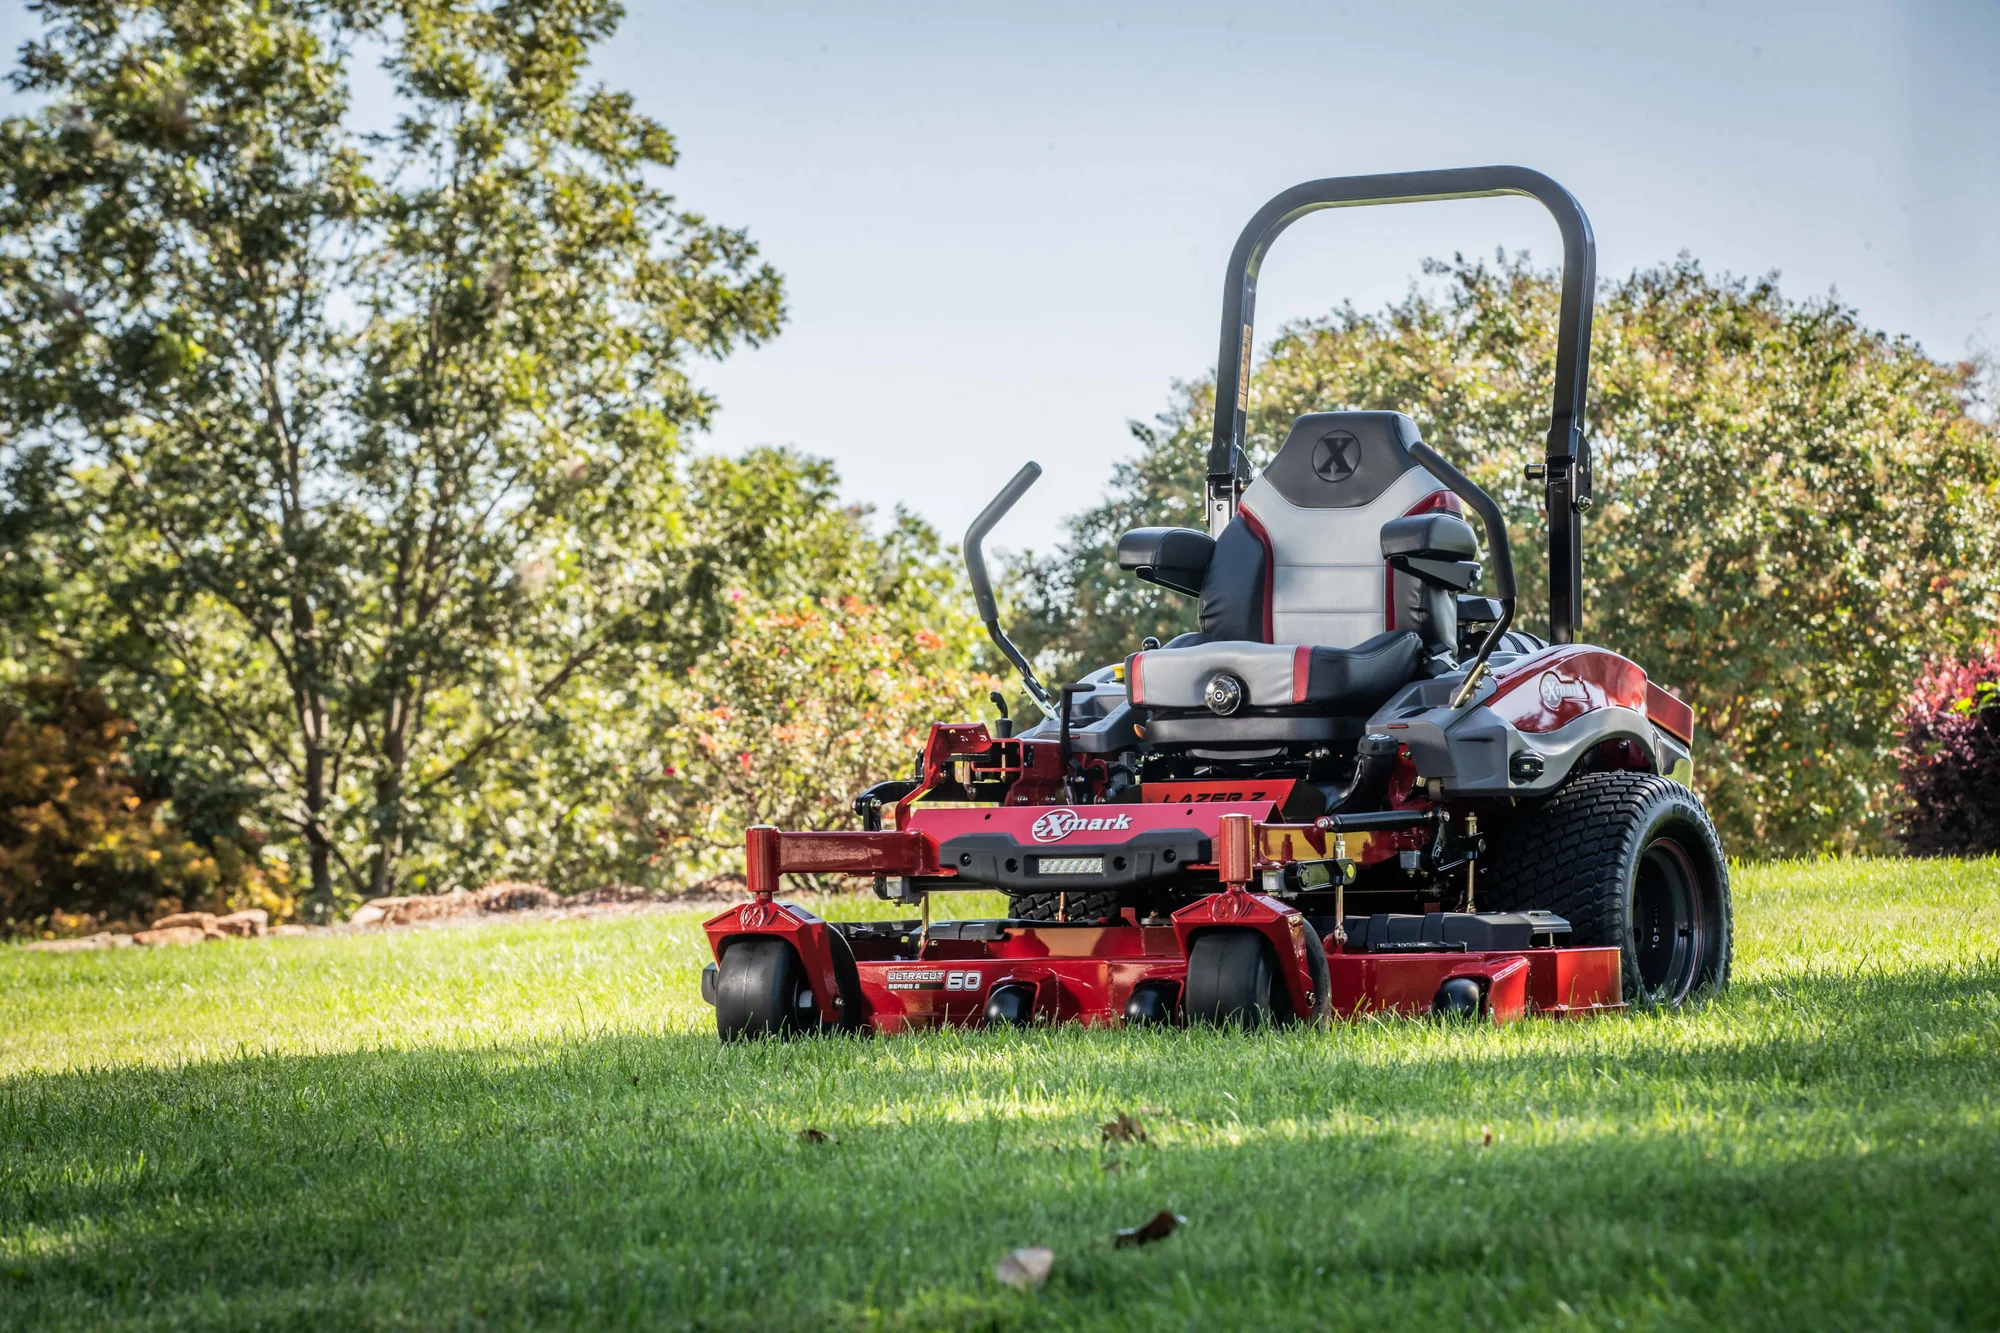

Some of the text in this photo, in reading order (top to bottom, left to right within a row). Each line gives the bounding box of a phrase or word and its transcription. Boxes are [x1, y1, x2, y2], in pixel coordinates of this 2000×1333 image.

[1162, 791, 1267, 803] LAZER Z
[1032, 813, 1133, 837] eXmark
[887, 971, 981, 991] ULTRACUT 60
